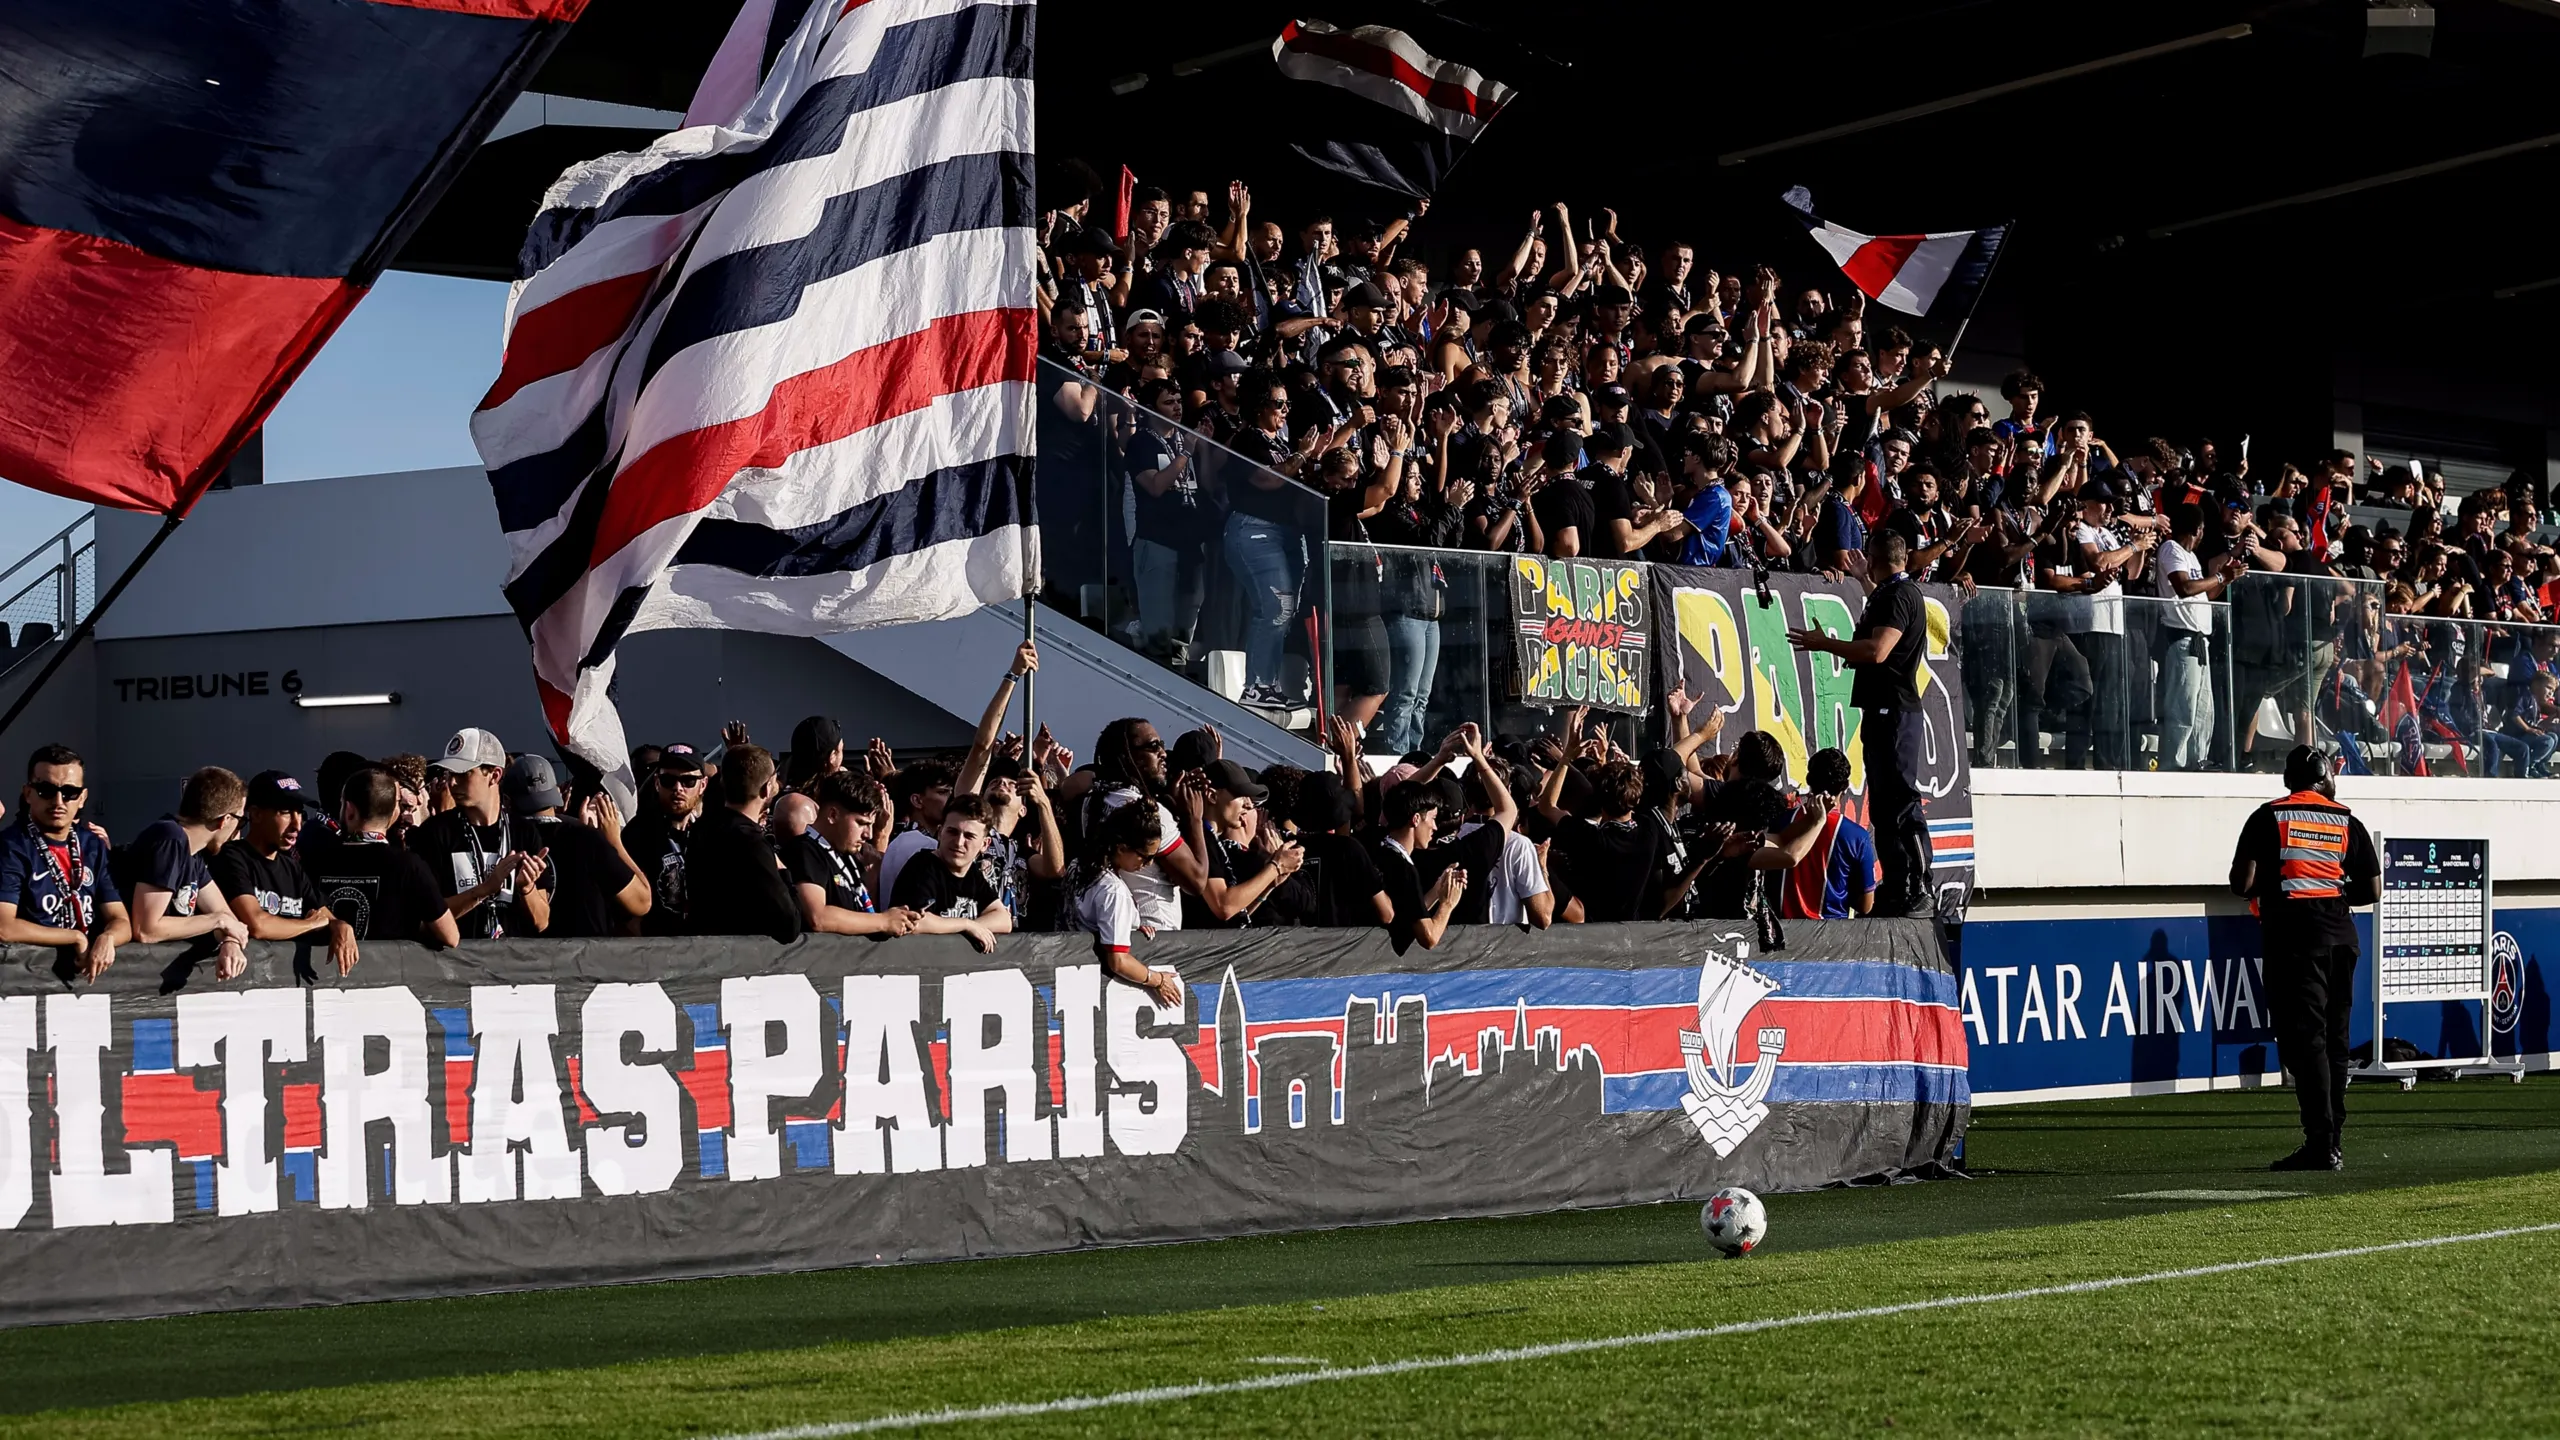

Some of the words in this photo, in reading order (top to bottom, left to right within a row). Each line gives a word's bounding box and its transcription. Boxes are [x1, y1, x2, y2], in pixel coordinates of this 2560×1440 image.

[1515, 556, 1643, 627] PARIS
[1541, 616, 1629, 650] AGAINST
[113, 670, 270, 703] TRIBUNE
[281, 668, 304, 694] 6
[1525, 637, 1643, 707] RACISM
[1671, 586, 1960, 798] PARS
[2289, 830, 2320, 840] SÉCURITÉ
[2319, 834, 2342, 843] PRIVÉE
[1961, 963, 2088, 1046] ATAR
[719, 963, 1188, 1182] PARIS
